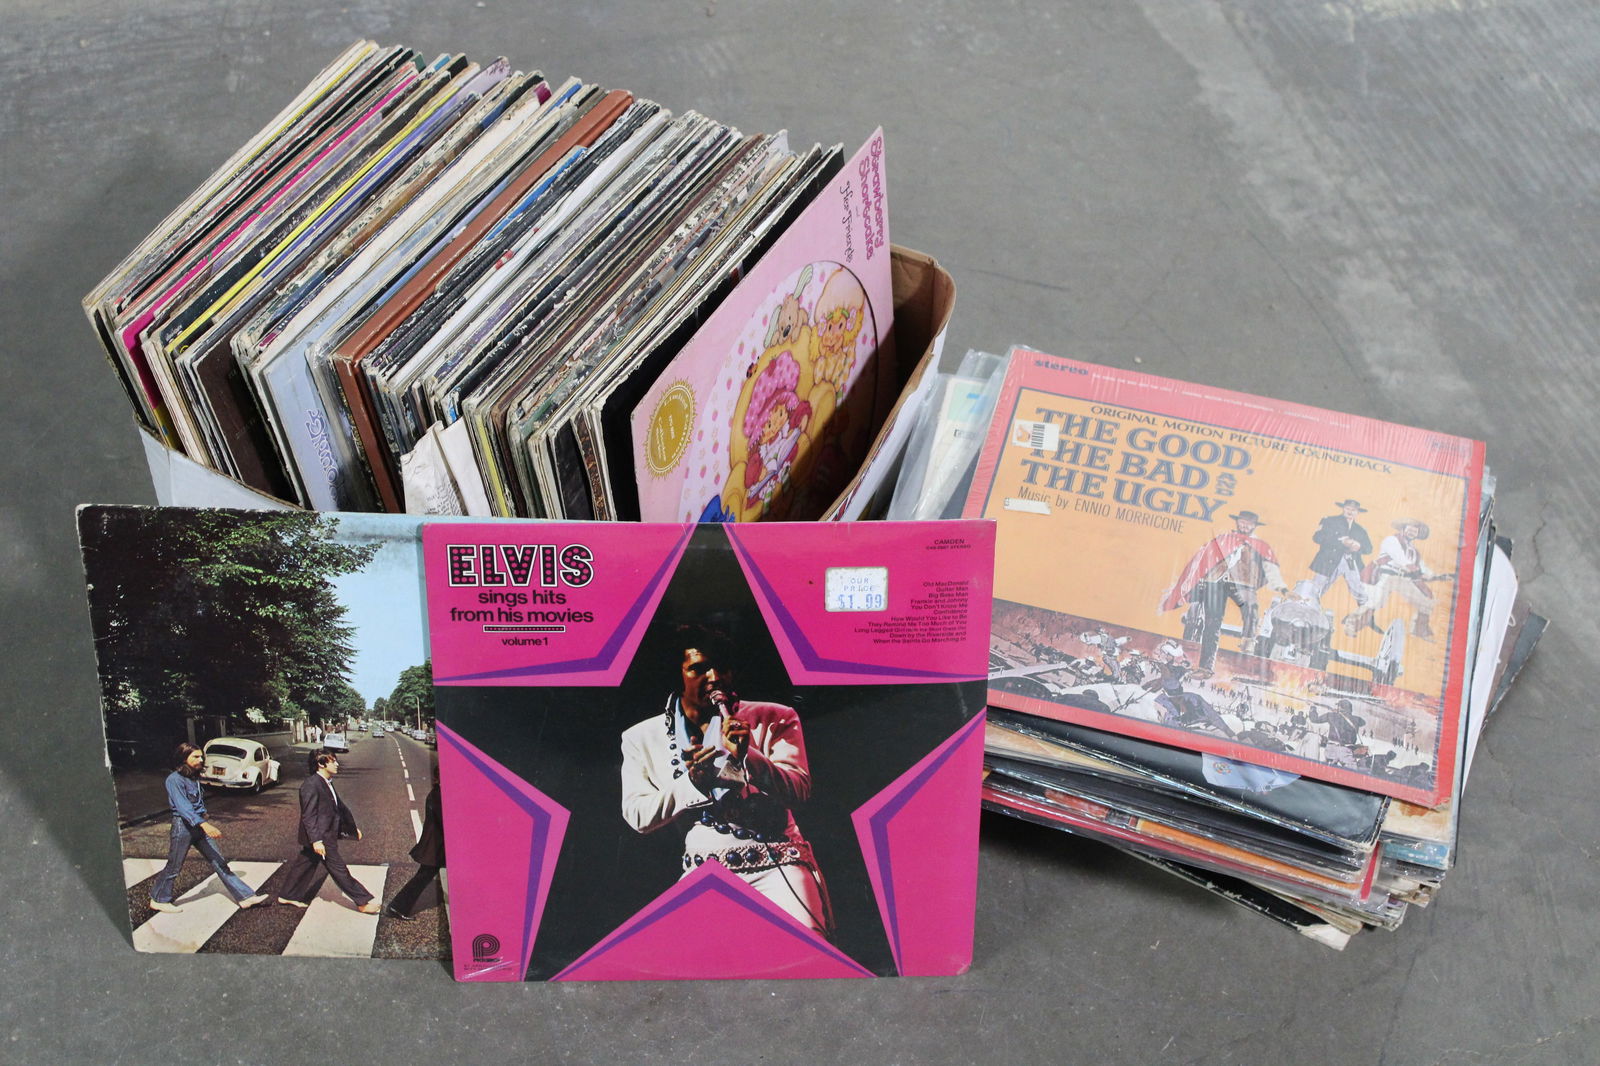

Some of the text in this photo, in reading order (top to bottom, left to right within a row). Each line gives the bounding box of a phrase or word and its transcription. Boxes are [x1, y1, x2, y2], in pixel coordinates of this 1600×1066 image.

[859, 155, 874, 260] Shortcake
[871, 136, 884, 248] Strawberry
[1034, 359, 1089, 376] stereo
[1090, 404, 1392, 474] ORIGINAL MOTION PICTURE SOUNDTRACK
[1030, 438, 1113, 472] HE
[1116, 451, 1209, 490] BAD
[1018, 485, 1052, 504] Music
[1055, 493, 1069, 510] by
[1074, 497, 1111, 518] ENNIO
[1115, 502, 1185, 534] MORRICONE
[1021, 458, 1228, 522] THE UGLY
[446, 543, 594, 588] ELVIS
[450, 607, 594, 622] from his movies
[478, 590, 567, 607] sings hits
[501, 636, 541, 646] volume
